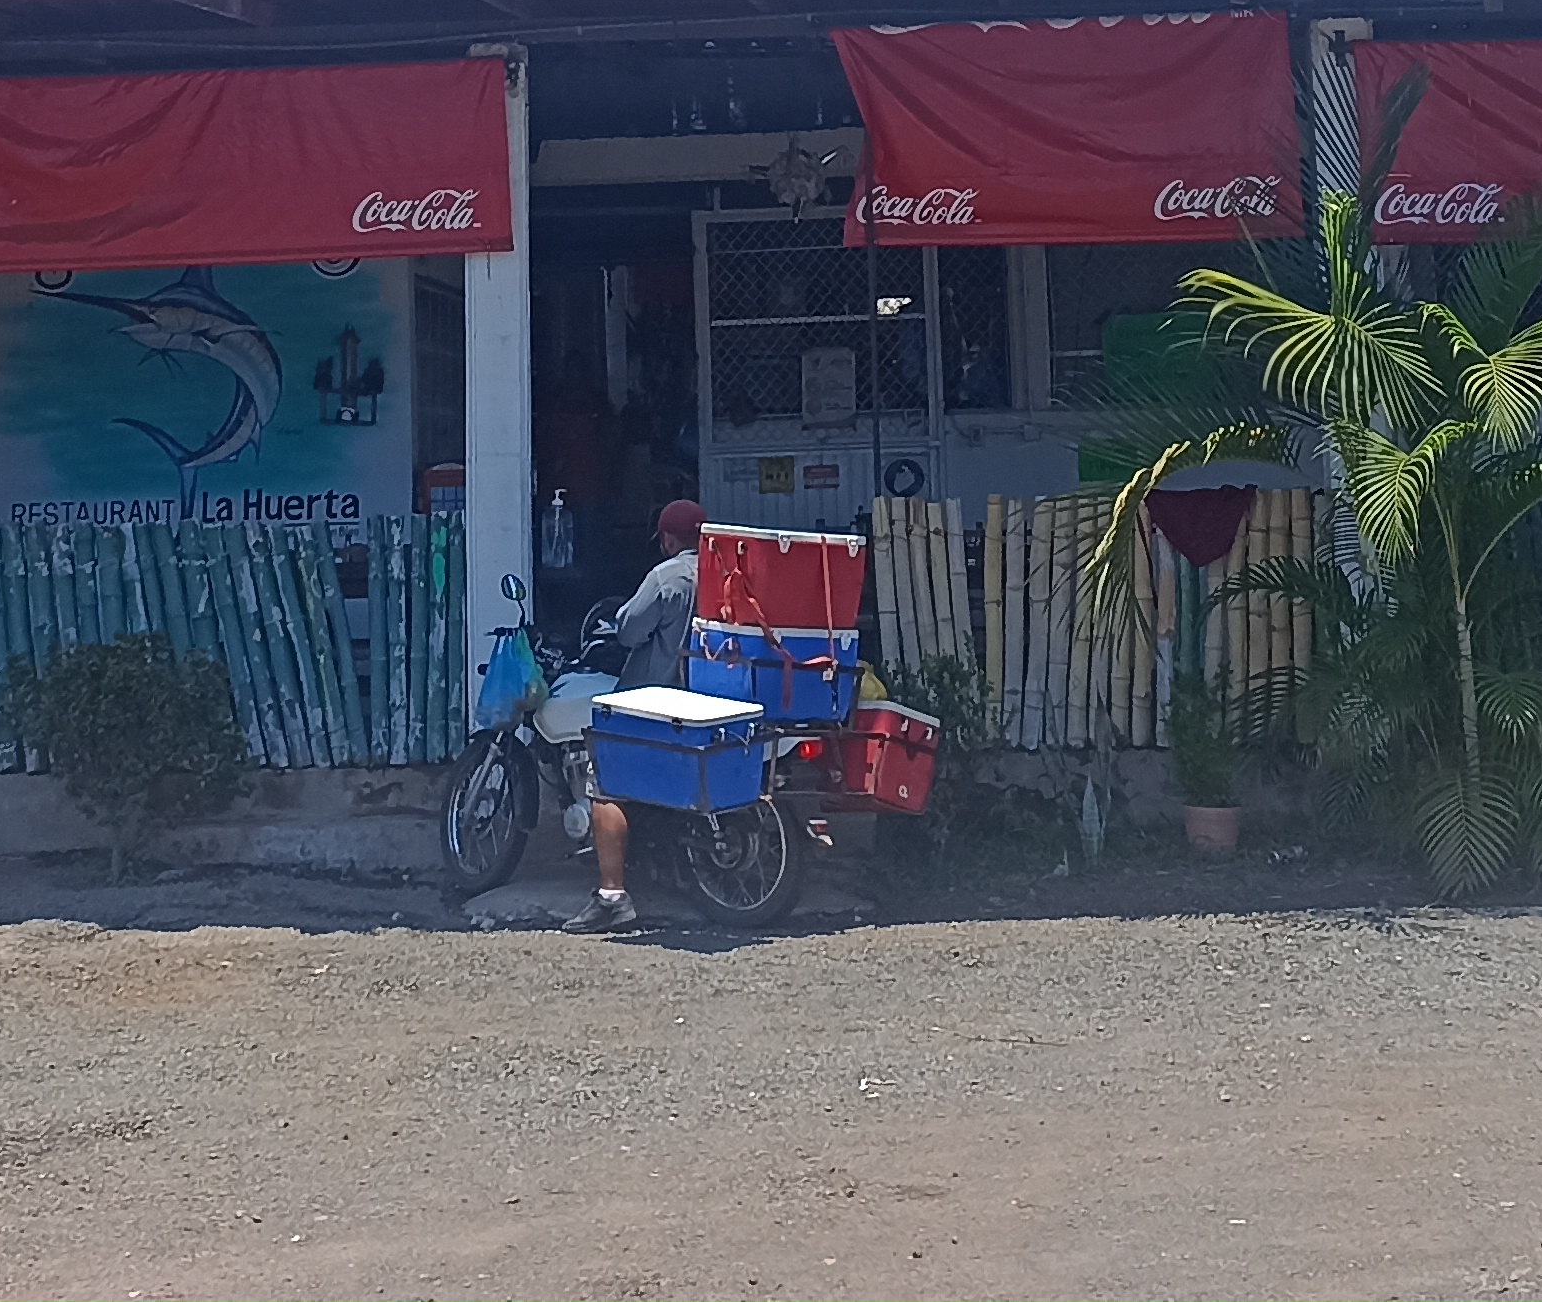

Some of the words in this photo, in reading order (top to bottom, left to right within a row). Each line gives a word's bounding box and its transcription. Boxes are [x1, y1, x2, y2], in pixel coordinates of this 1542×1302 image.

[352, 189, 481, 233] Coca-Cola
[855, 185, 980, 225] Coca-Cola
[1374, 183, 1504, 224] Coca-Cola
[11, 499, 175, 526] RESTAURANT
[202, 490, 233, 524] La
[243, 488, 360, 521] Huerta
